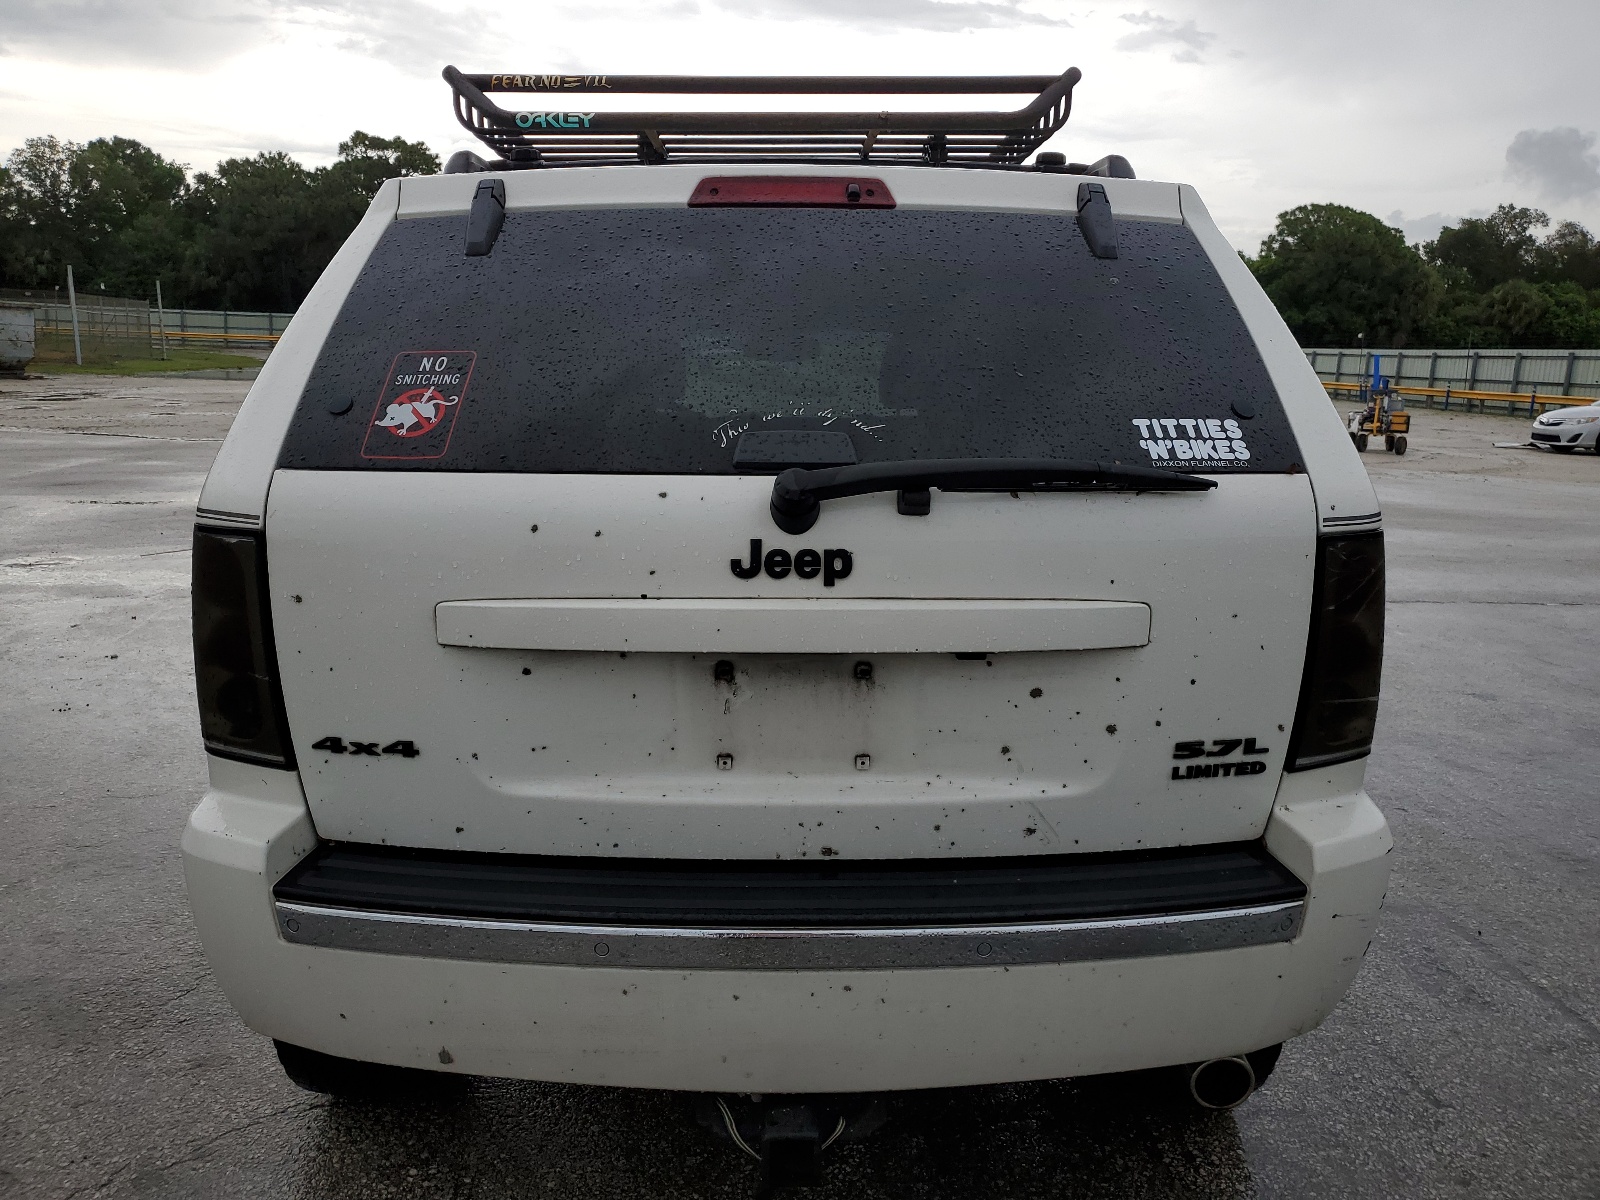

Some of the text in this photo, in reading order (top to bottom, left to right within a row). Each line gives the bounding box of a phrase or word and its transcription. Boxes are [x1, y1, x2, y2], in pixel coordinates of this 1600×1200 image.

[491, 74, 537, 91] FEAR
[538, 74, 561, 89] NO
[515, 111, 596, 128] OAKLEY
[419, 356, 448, 372] NO
[395, 374, 460, 385] SNITCHING
[1132, 418, 1243, 439] TITTIES
[730, 538, 853, 587] Jeep
[312, 736, 420, 758] 4x4
[1173, 738, 1270, 759] 5.7L
[1171, 761, 1267, 780] LIMITED
